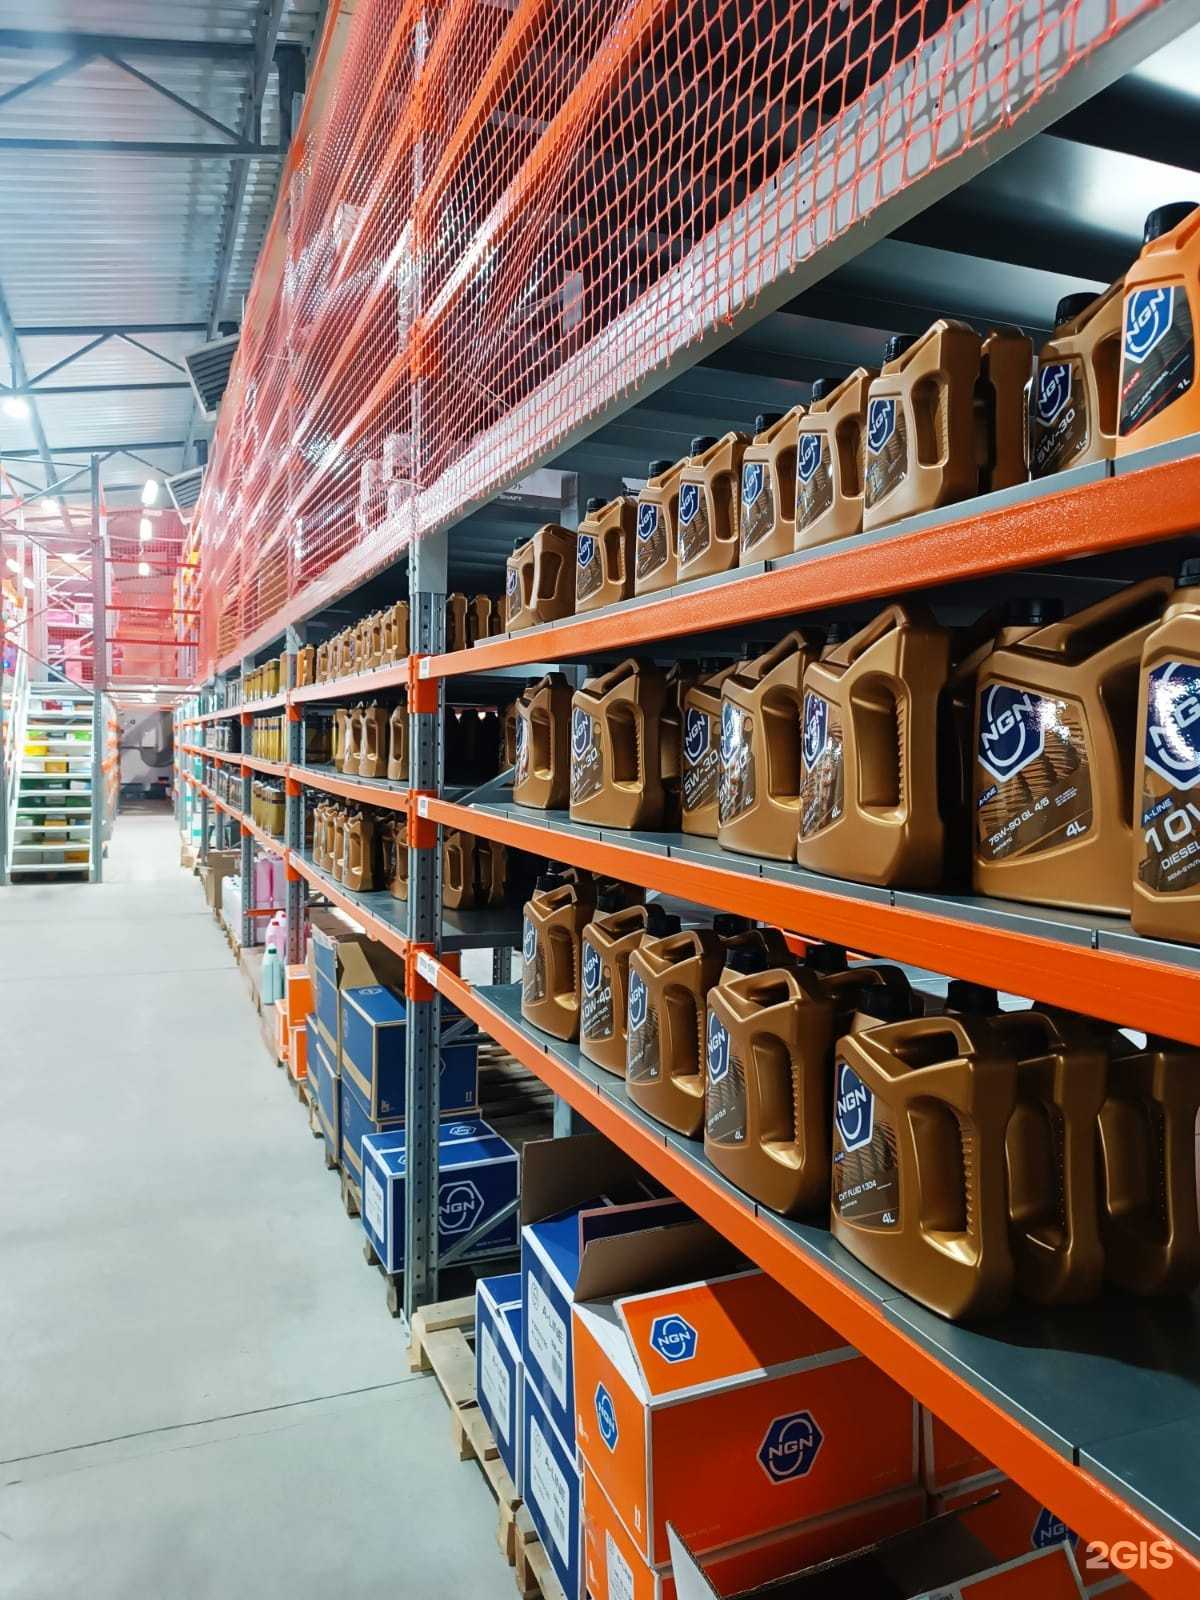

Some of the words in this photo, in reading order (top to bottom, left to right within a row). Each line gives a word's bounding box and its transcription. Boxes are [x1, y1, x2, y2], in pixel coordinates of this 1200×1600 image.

[1126, 288, 1165, 343] NGN
[1039, 366, 1065, 412] NGN
[686, 715, 705, 746] NGN
[981, 693, 1033, 749] NGN
[685, 750, 719, 795] 5W-30
[1143, 798, 1173, 824] A-LINE
[1066, 821, 1087, 837] 4L
[708, 1029, 725, 1052] NGN
[838, 1085, 867, 1116] NGN
[439, 1200, 475, 1215] NGN
[882, 1212, 895, 1225] 4L
[658, 1331, 691, 1347] NGN
[769, 1435, 813, 1459] NGN
